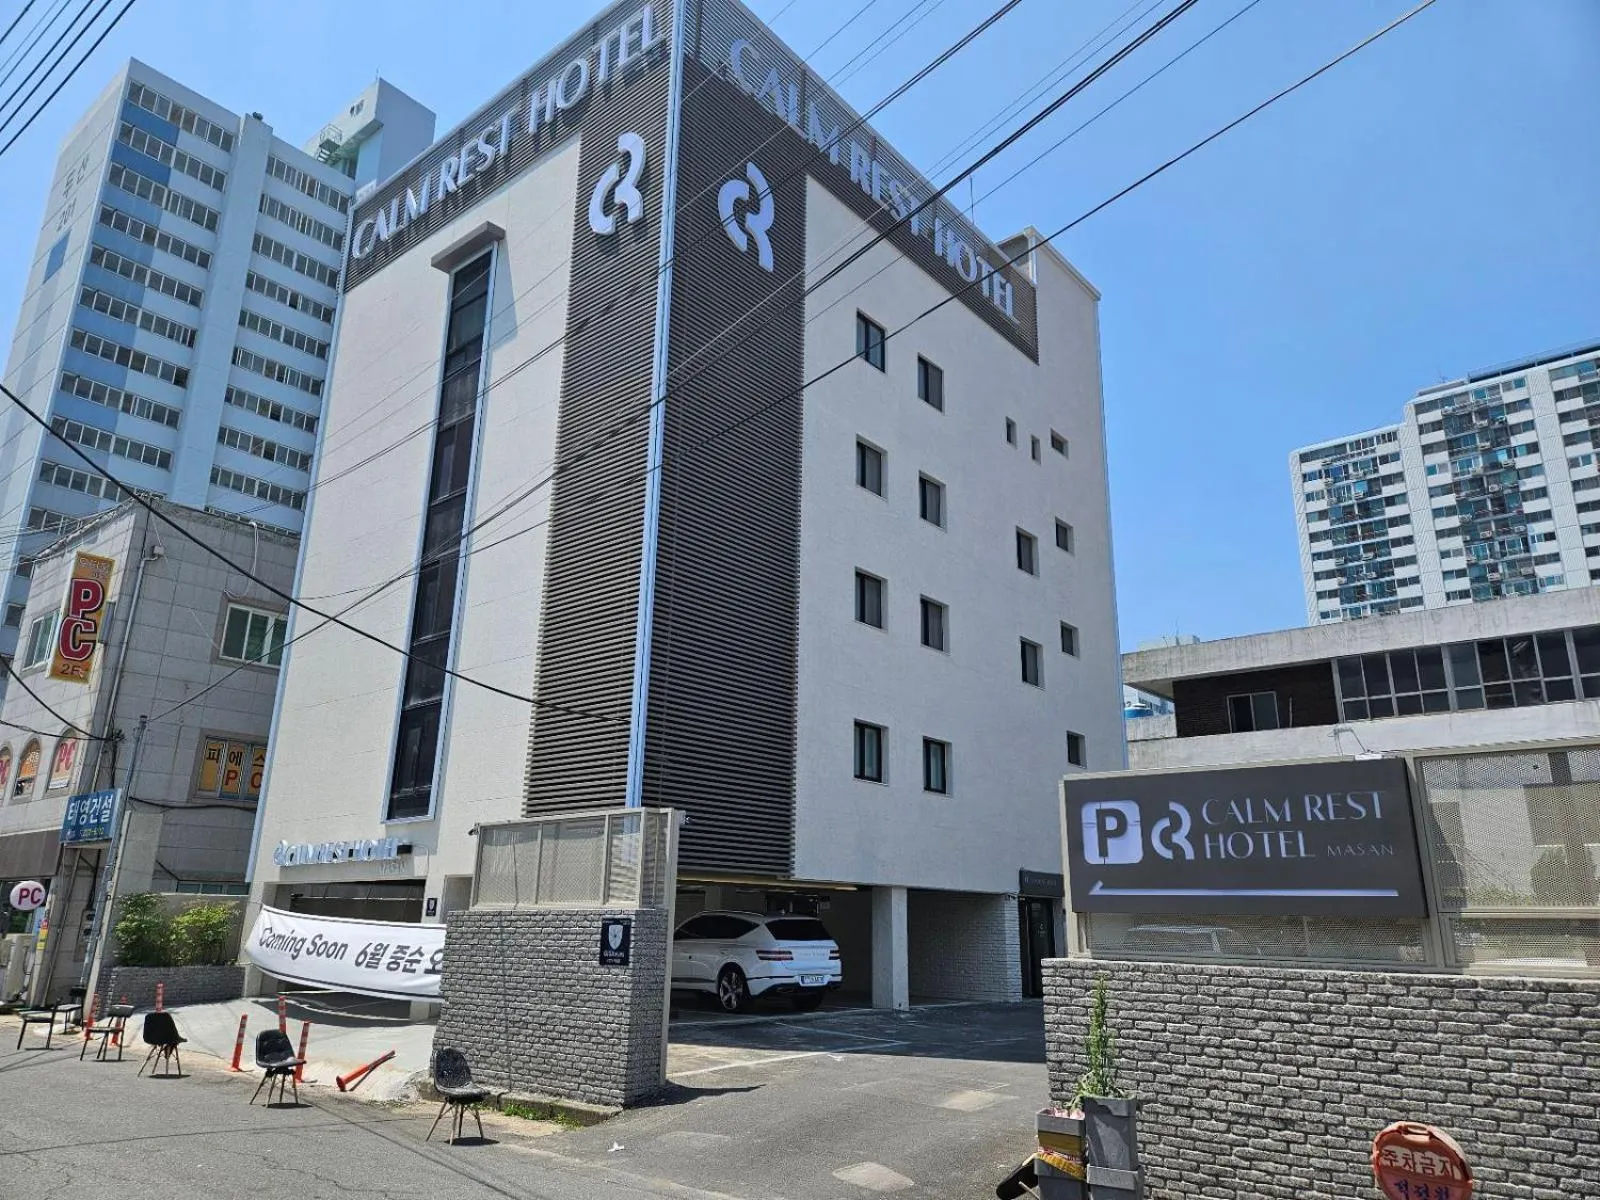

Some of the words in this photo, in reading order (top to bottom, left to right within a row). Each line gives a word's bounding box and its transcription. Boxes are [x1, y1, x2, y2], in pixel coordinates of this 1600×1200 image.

[351, 171, 433, 259] CALM
[437, 108, 520, 200] REST
[527, 4, 667, 134] HOTEL
[728, 36, 841, 166] CALM
[850, 138, 925, 237] REST
[934, 216, 1021, 327] HOTEL
[58, 577, 105, 661] PC
[1202, 797, 1292, 826] CALM
[1303, 790, 1388, 822] REST
[1203, 829, 1317, 860] HOTEL
[1327, 843, 1395, 858] MASAN
[17, 887, 43, 905] PC
[258, 925, 308, 961] Coming
[305, 932, 349, 961] Soon
[353, 941, 391, 970] 6월
[385, 944, 426, 974] 중순
[1382, 1148, 1456, 1181] 주차금지
